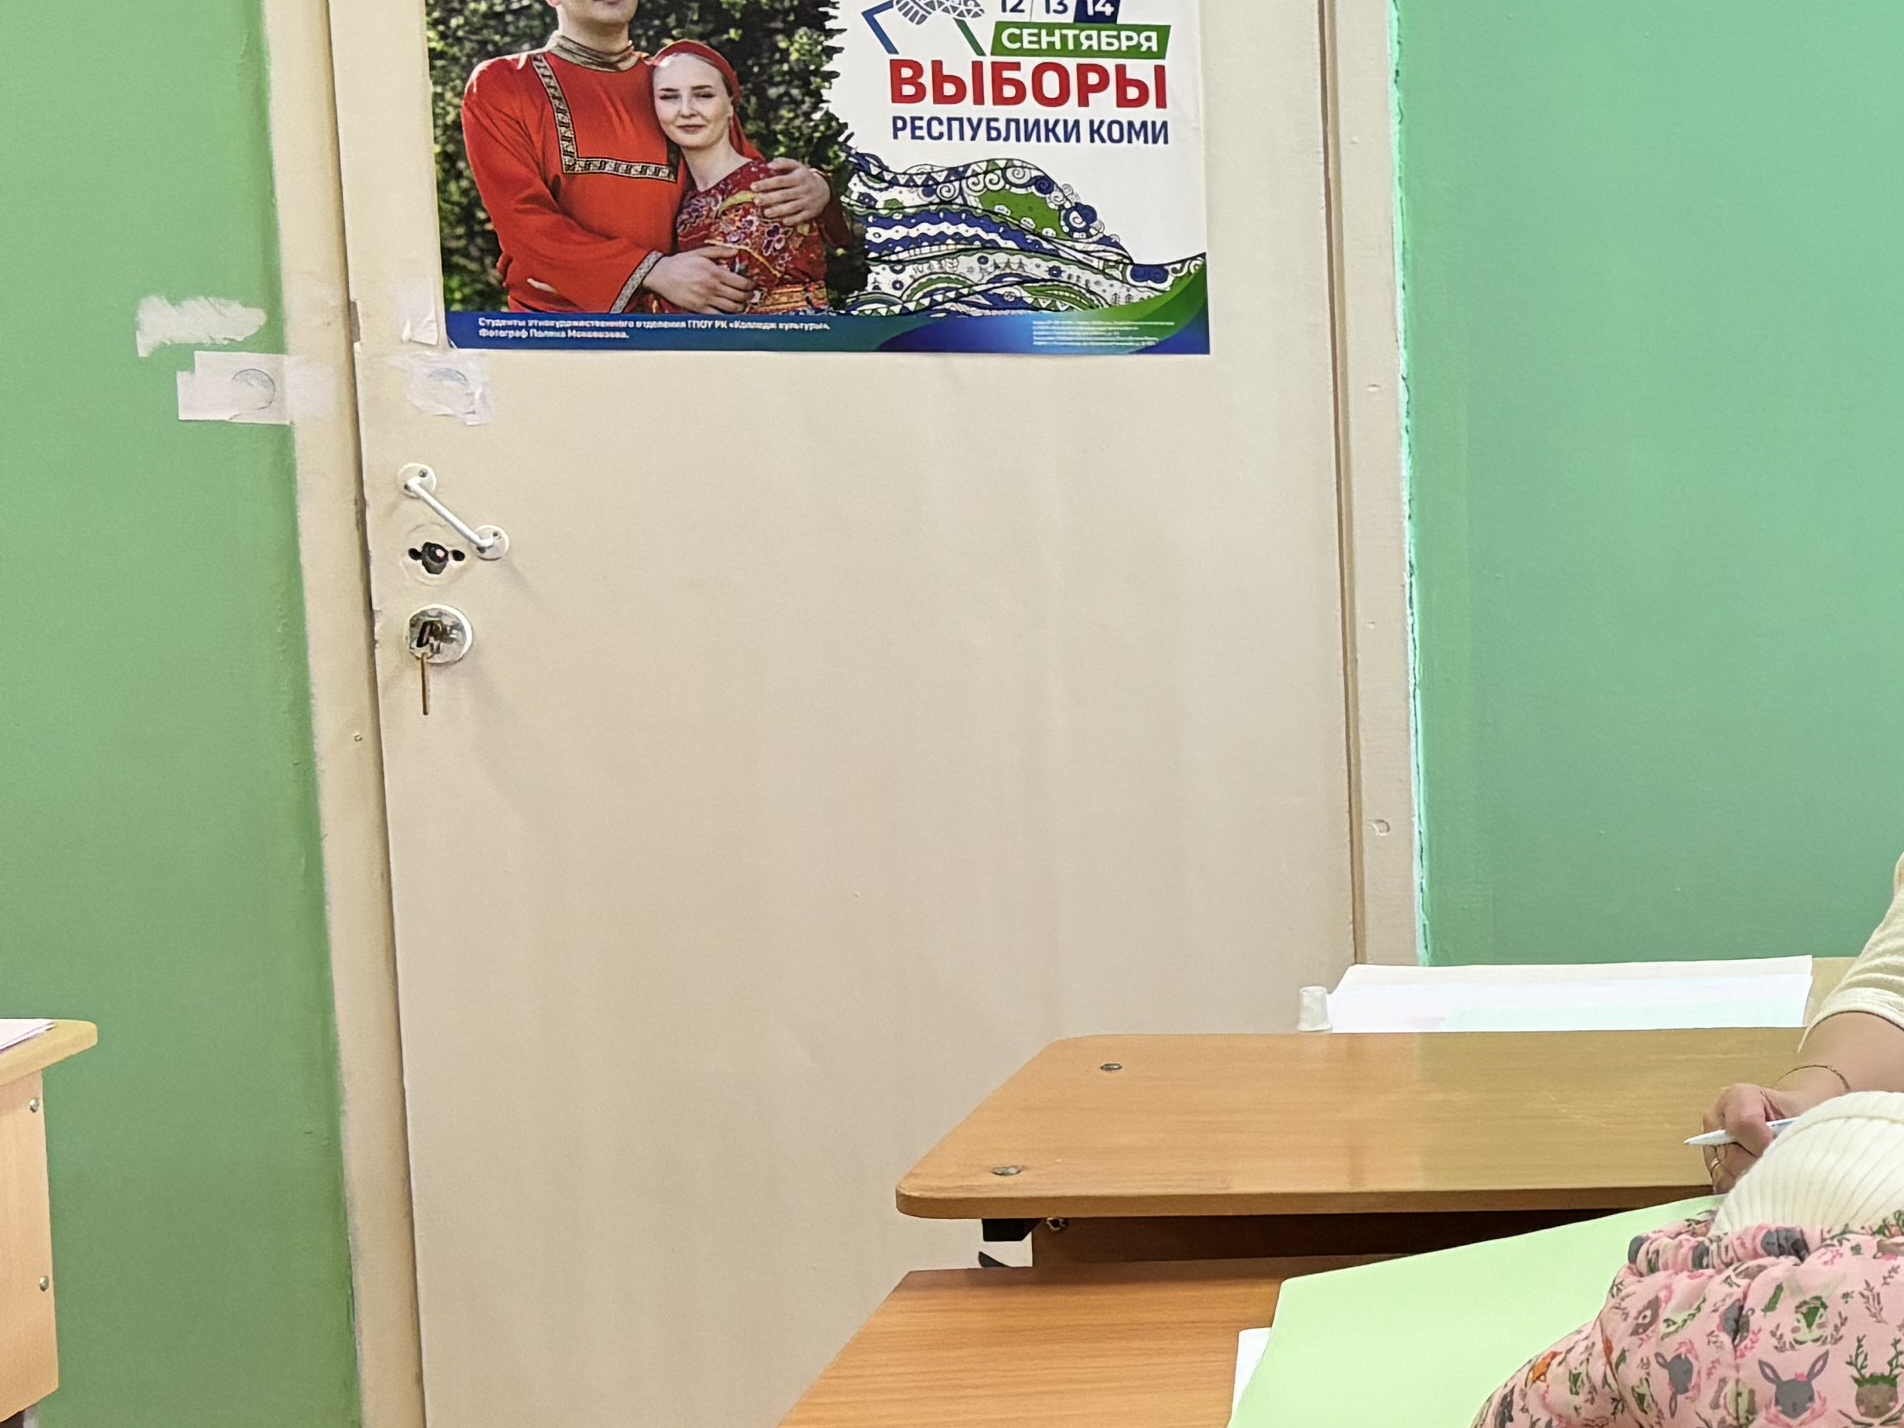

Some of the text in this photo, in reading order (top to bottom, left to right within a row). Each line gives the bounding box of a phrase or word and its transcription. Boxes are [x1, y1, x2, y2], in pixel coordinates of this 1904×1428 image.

[1001, 28, 1158, 52] СЕНТЯБРЯ
[889, 59, 1168, 109] ВЫБОРЫ
[892, 116, 1169, 145] РЕСПУБЛИКИ КОМИ
